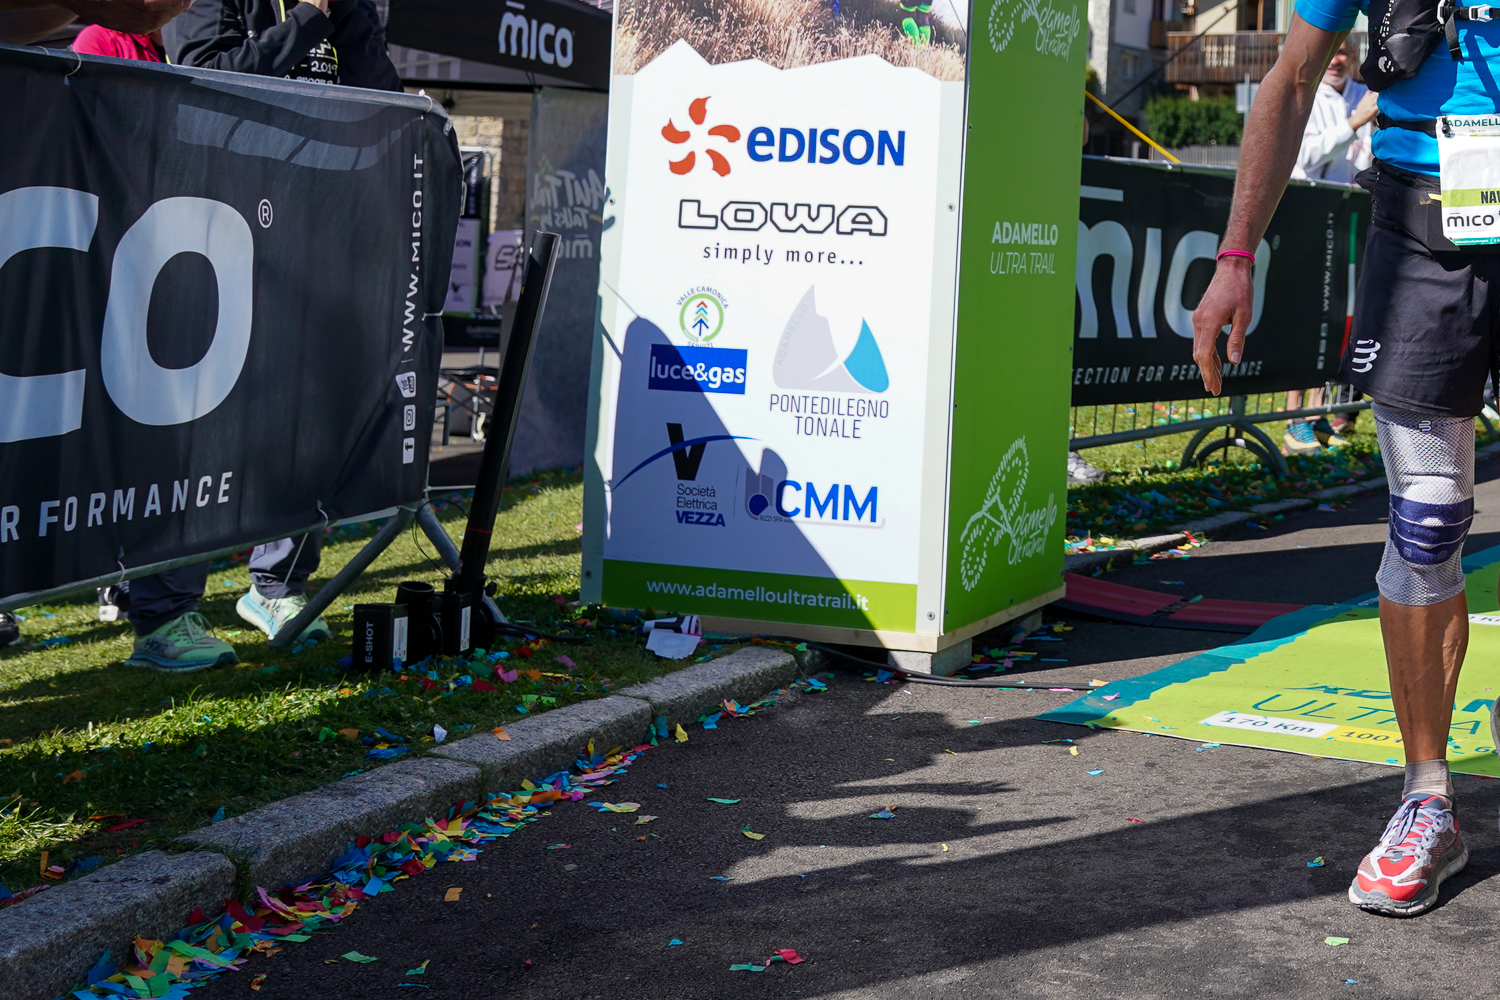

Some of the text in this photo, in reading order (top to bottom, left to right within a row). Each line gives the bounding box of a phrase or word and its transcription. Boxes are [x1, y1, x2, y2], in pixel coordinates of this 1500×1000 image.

[310, 60, 338, 76] 2019
[678, 198, 888, 237] LOWA
[991, 221, 1058, 246] ADAMELLO
[402, 153, 424, 352] WWW.MICOIT
[702, 242, 864, 265] simply more...
[990, 251, 1056, 274] ULTRA TRAIL
[676, 285, 729, 310] VALLE CAMONICA
[776, 303, 809, 367] ADAMELLO
[650, 355, 746, 389] luce&gas
[1136, 365, 1164, 383] FOR
[1169, 360, 1264, 382] PERMANCE
[769, 393, 890, 419] PONTEDILEGNO
[794, 415, 862, 439] TONALE
[676, 483, 716, 498] Società
[775, 479, 878, 523] CMM
[676, 497, 718, 511] Elettrica
[675, 510, 726, 527] VEZZA
[646, 580, 869, 611] www.adamelloultratrail.it
[365, 621, 374, 663] E-SHOT
[1220, 716, 1389, 743] 170 Km 100
